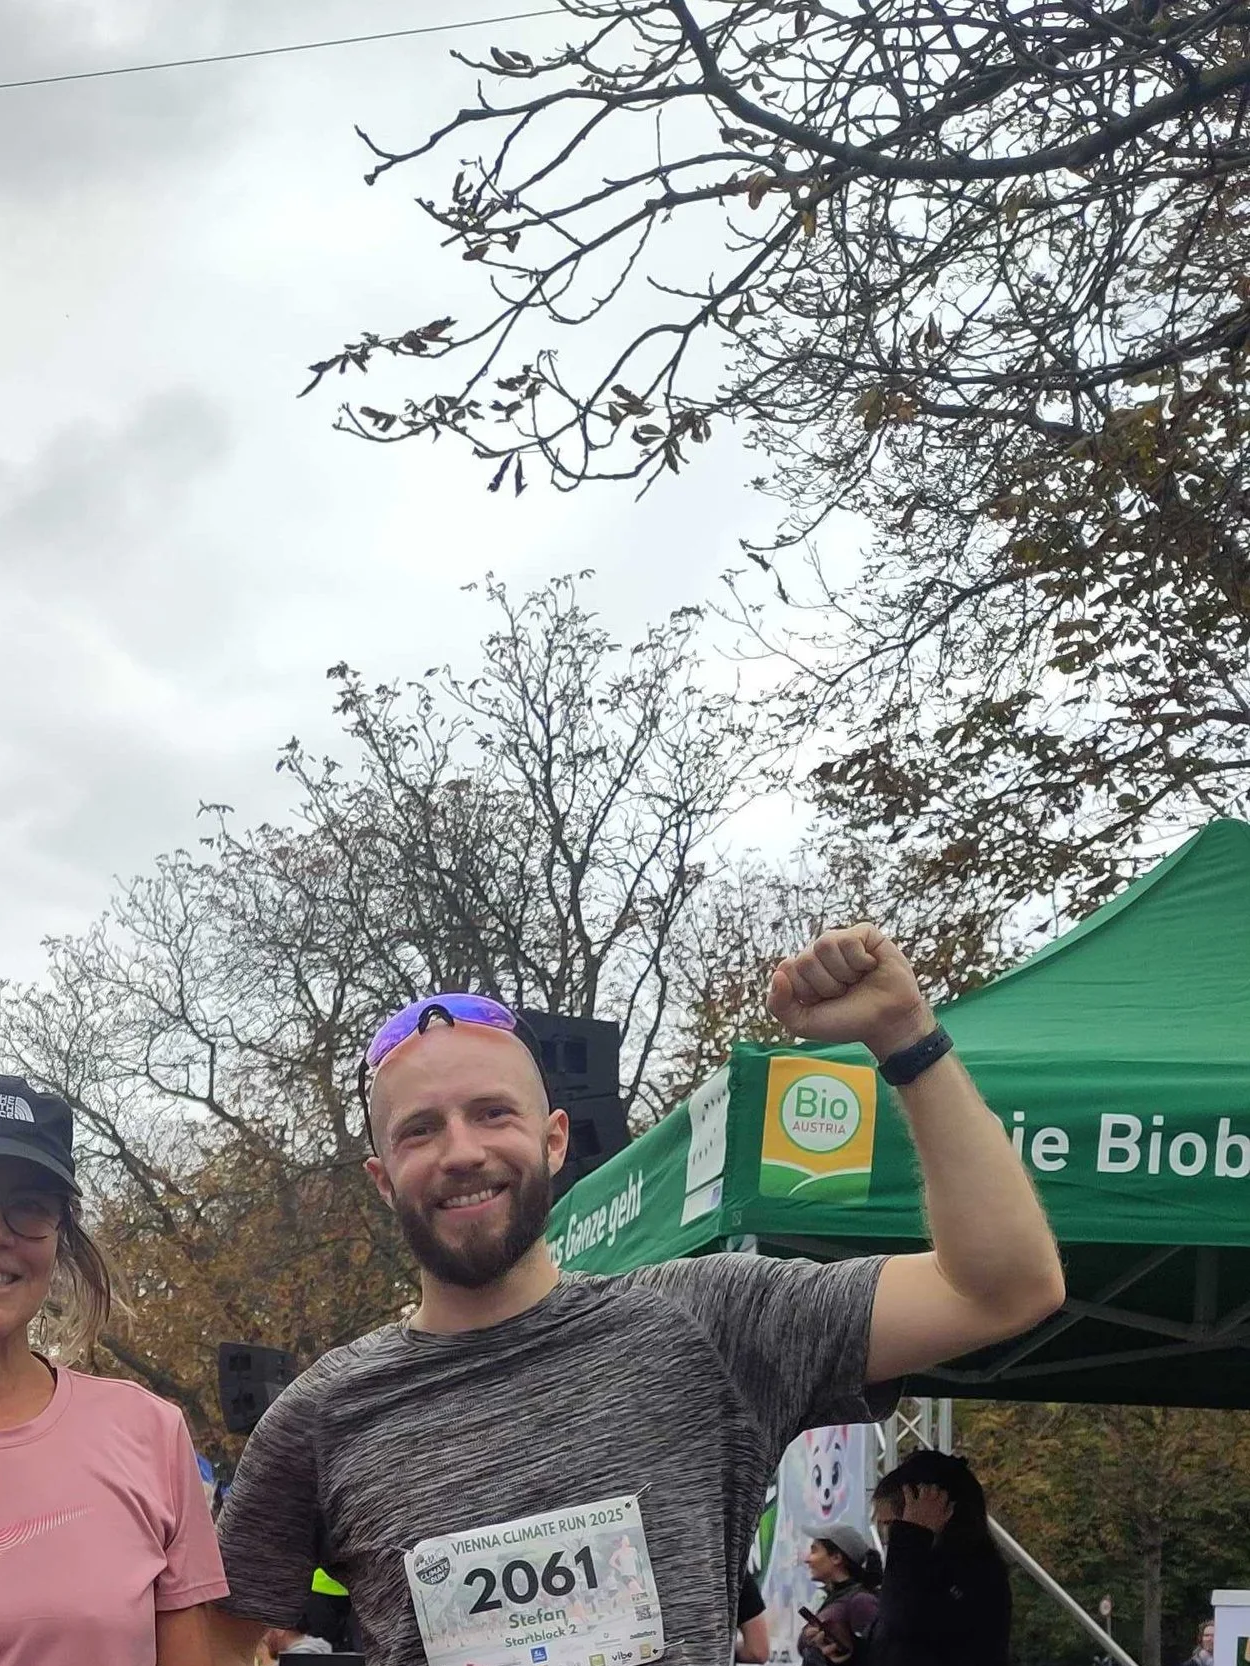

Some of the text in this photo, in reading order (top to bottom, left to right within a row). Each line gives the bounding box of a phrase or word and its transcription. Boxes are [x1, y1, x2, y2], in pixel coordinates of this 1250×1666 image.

[795, 1086, 848, 1120] Bio
[792, 1121, 846, 1134] AUSTRIA
[1011, 1111, 1250, 1179] ie Biob
[565, 1205, 607, 1261] Ganze
[607, 1169, 643, 1248] geht
[451, 1510, 624, 1556] VIENNA CLIMATE RUN 2025
[420, 1561, 449, 1581] CLIMATE
[430, 1572, 447, 1585] RUN
[462, 1545, 599, 1616] 2061
[508, 1607, 567, 1629] Stefan
[505, 1624, 578, 1648] Startblock 2
